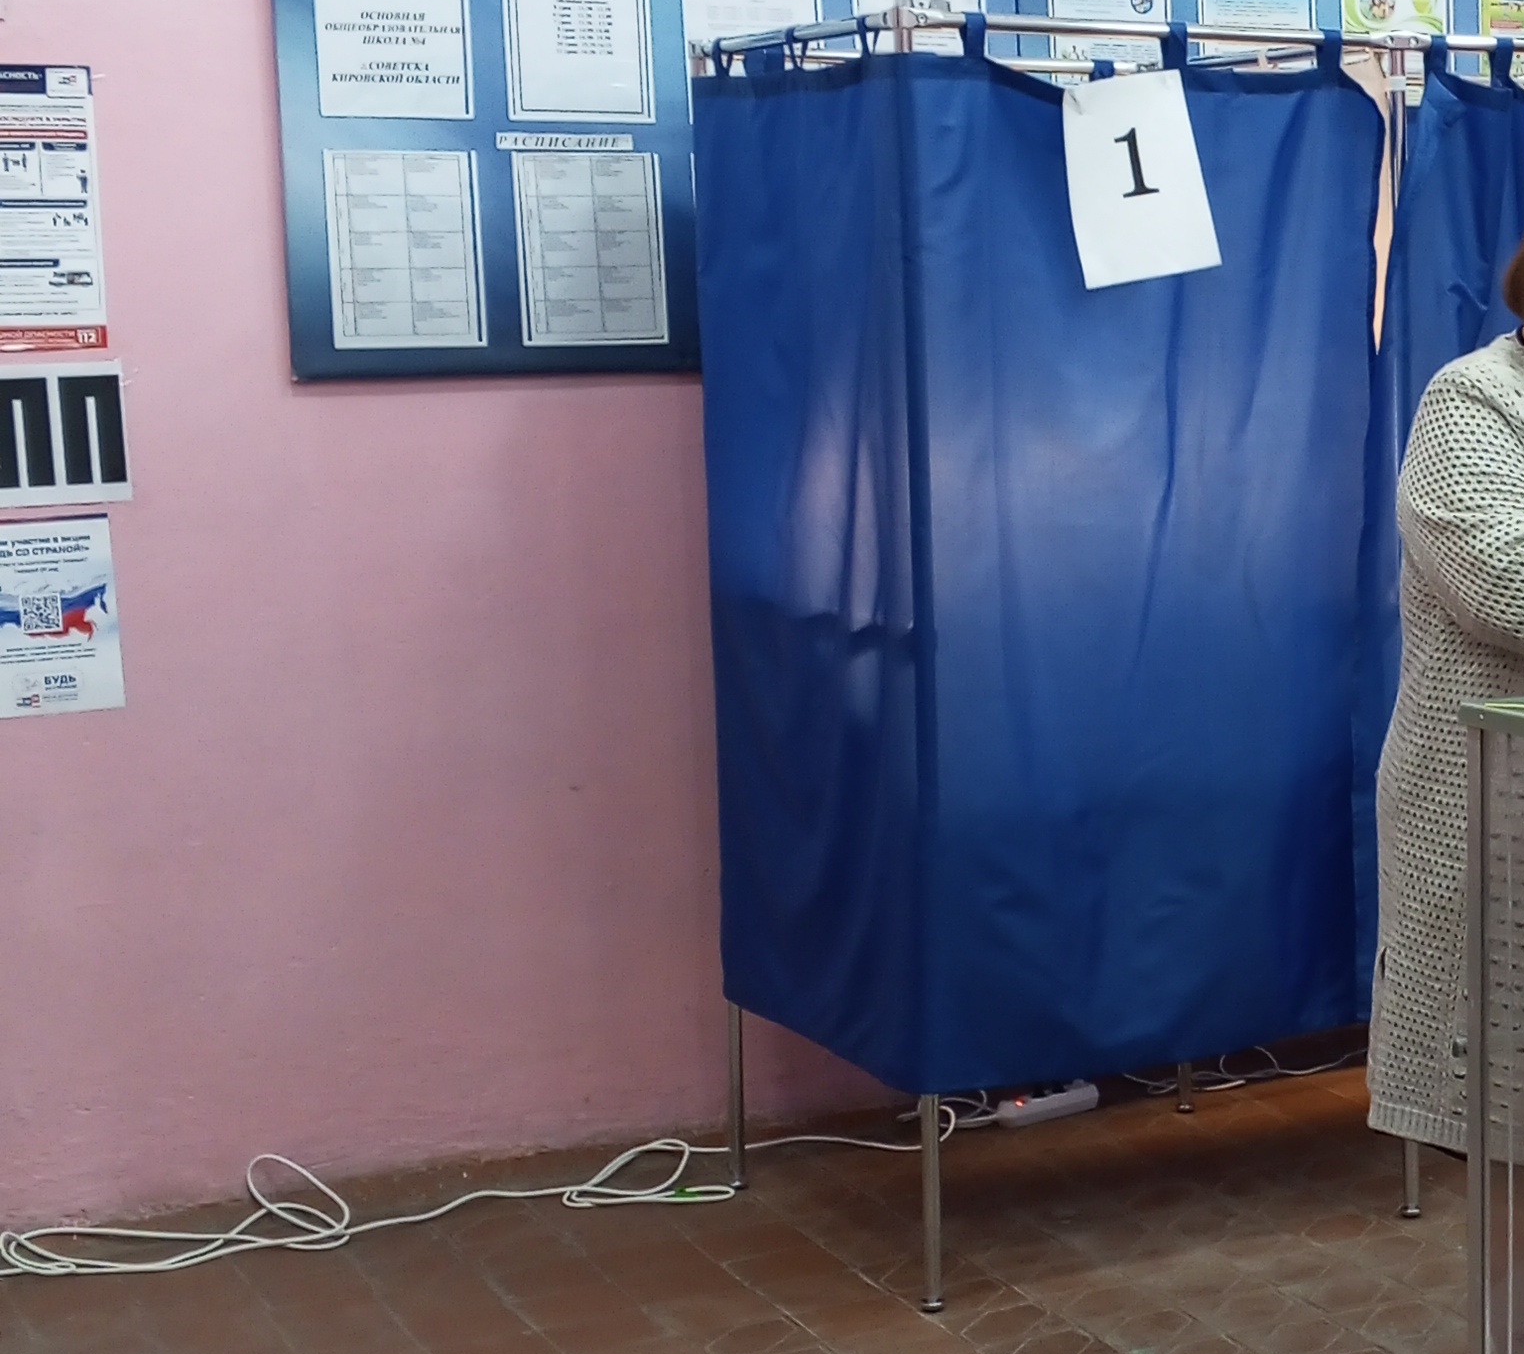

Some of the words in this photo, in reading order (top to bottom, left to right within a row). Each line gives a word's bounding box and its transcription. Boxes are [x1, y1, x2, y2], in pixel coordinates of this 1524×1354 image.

[360, 11, 425, 22] ОСНОВНАЯ
[499, 135, 620, 149] РАСПИСАНИЕ
[1114, 127, 1160, 199] 1
[80, 331, 98, 344] 112
[44, 674, 77, 687] БУДЬ
